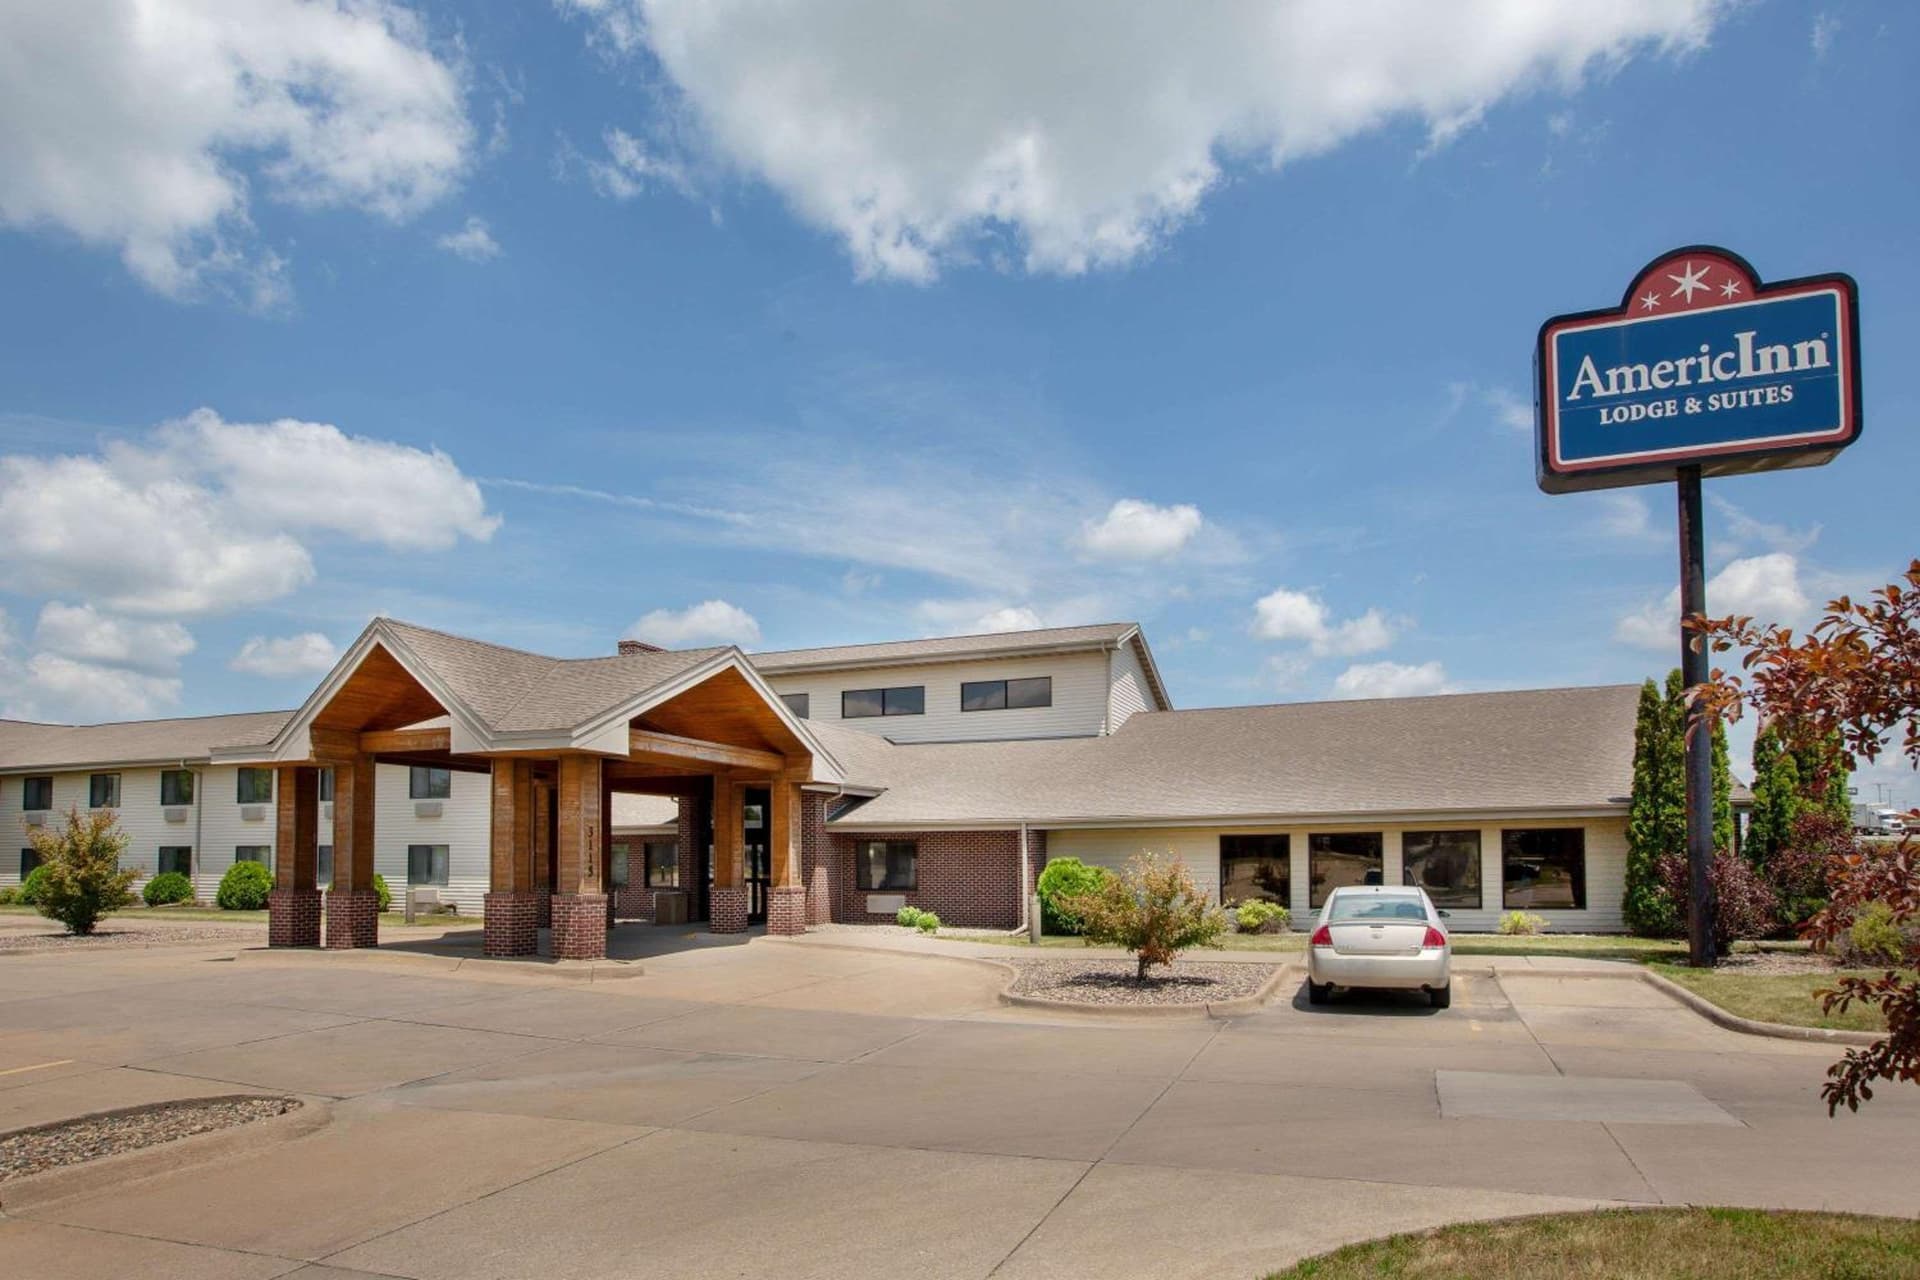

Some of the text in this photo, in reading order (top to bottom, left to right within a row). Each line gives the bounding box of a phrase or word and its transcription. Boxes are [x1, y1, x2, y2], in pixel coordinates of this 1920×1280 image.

[1567, 331, 1830, 400] AmericInn
[1600, 385, 1793, 424] LODGE & SUITES
